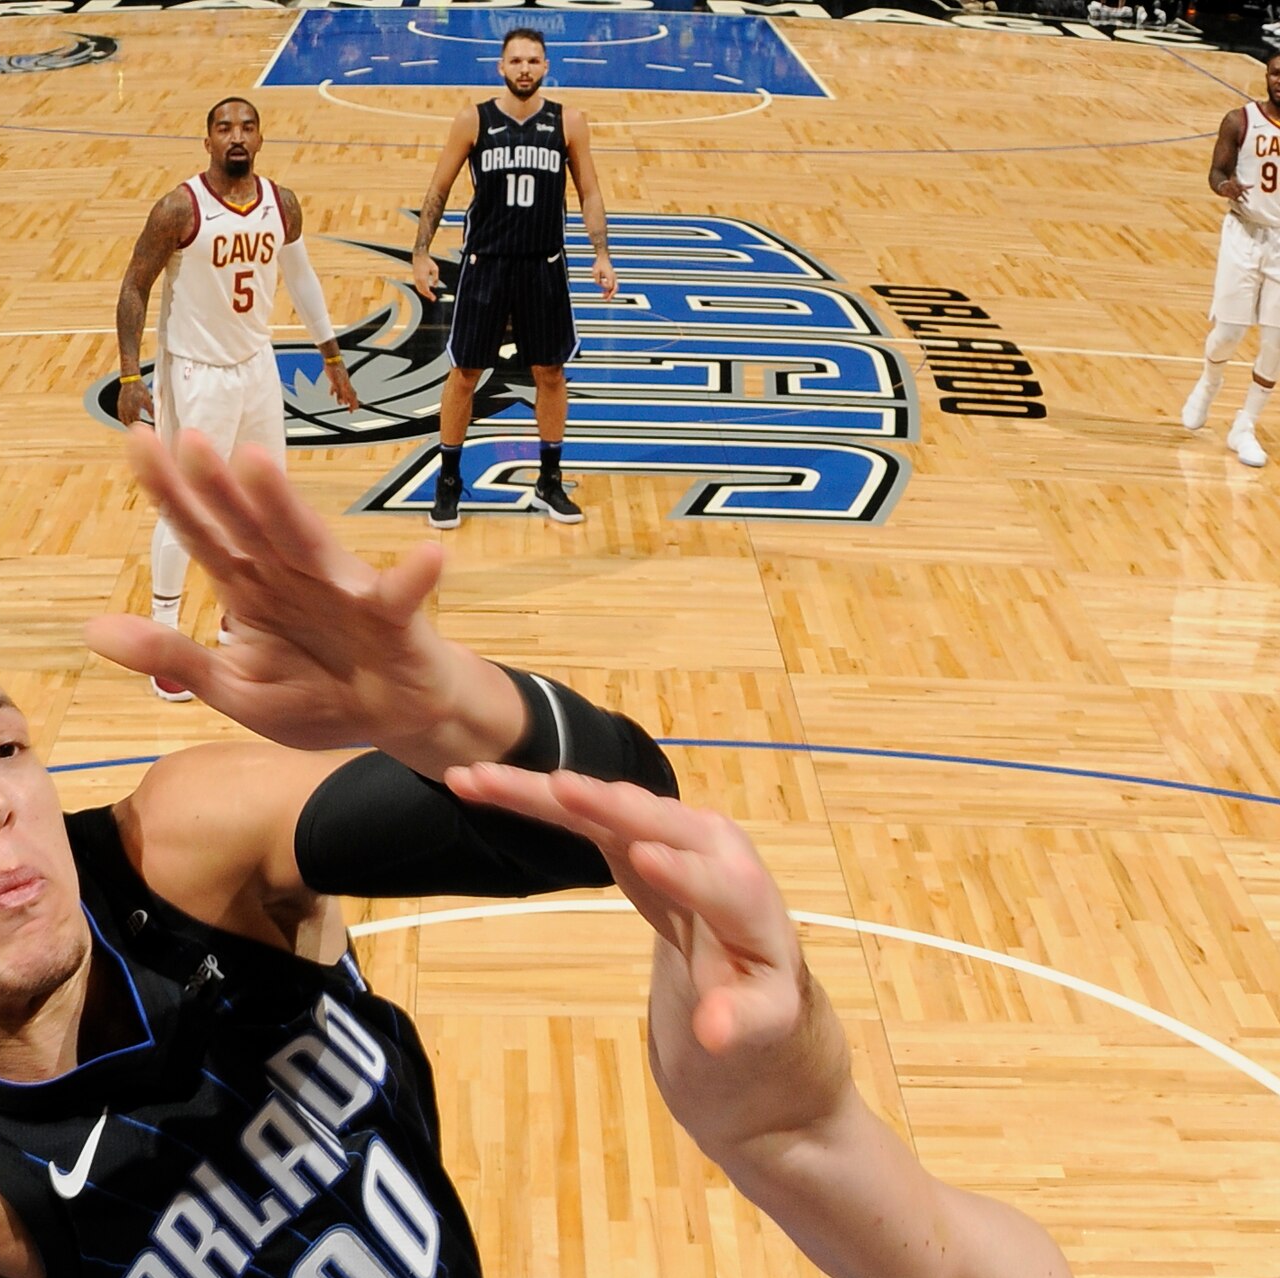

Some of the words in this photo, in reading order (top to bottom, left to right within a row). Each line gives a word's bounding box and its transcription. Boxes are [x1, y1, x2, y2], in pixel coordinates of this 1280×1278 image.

[481, 145, 561, 174] ORLANDO
[506, 173, 536, 208] 10
[211, 231, 276, 268] CAVS
[232, 270, 255, 314] 5
[869, 284, 1048, 420] ORLANDO
